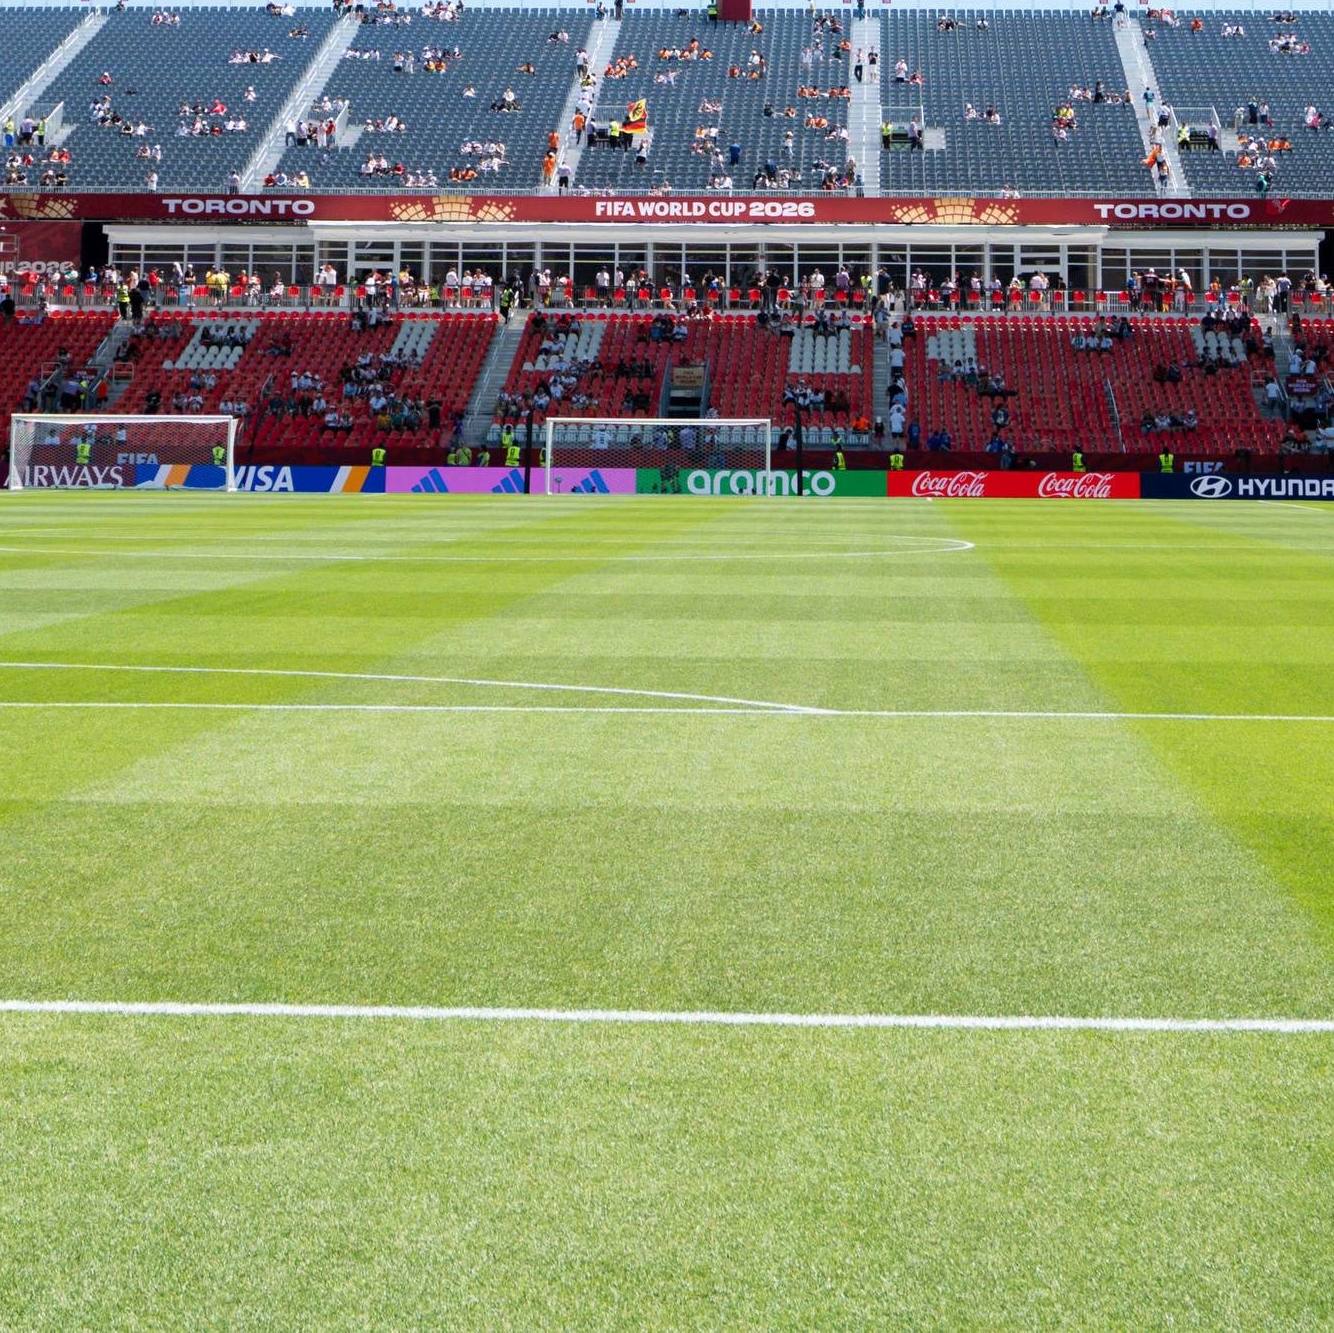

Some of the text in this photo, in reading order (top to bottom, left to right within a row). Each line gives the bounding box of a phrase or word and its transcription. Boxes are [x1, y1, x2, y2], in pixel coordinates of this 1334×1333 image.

[162, 199, 315, 214] TORONTO
[595, 201, 815, 217] FIFA WORLD CUP 2026
[1093, 204, 1250, 218] TORONTO
[117, 452, 158, 465] FIFA
[4, 465, 123, 487] AIRWAYS
[687, 470, 835, 496] aramco
[912, 471, 988, 497] Coca-Cola
[1038, 472, 1115, 498] Coca-Cola
